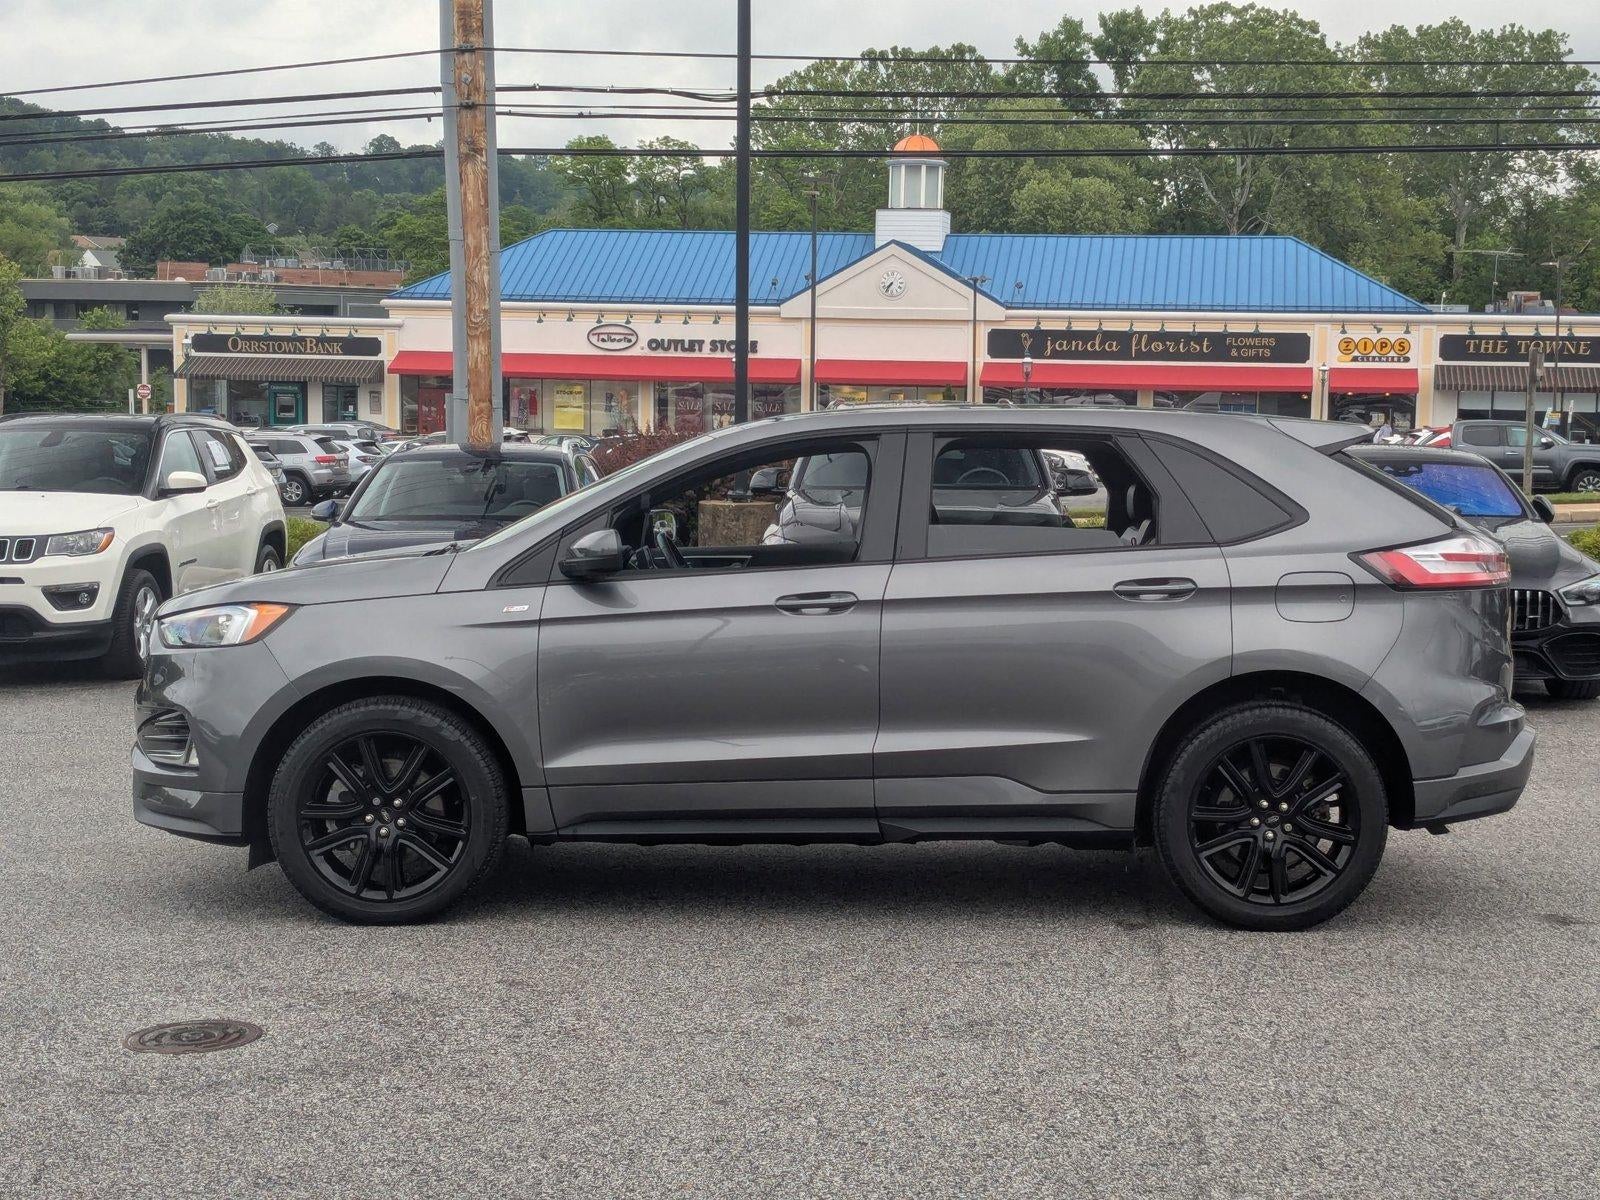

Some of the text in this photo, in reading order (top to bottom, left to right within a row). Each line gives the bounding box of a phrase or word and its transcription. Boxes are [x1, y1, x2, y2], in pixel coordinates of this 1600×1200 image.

[591, 331, 635, 343] Talbots
[1226, 337, 1276, 346] FLOWERS
[647, 339, 758, 354] OUTLET STOE
[1043, 333, 1213, 358] janda florist
[1341, 339, 1407, 353] ZIPS
[1465, 339, 1508, 354] THE
[1230, 348, 1271, 357] & GIFTS
[714, 402, 736, 411] SAL
[756, 402, 783, 412] SALE
